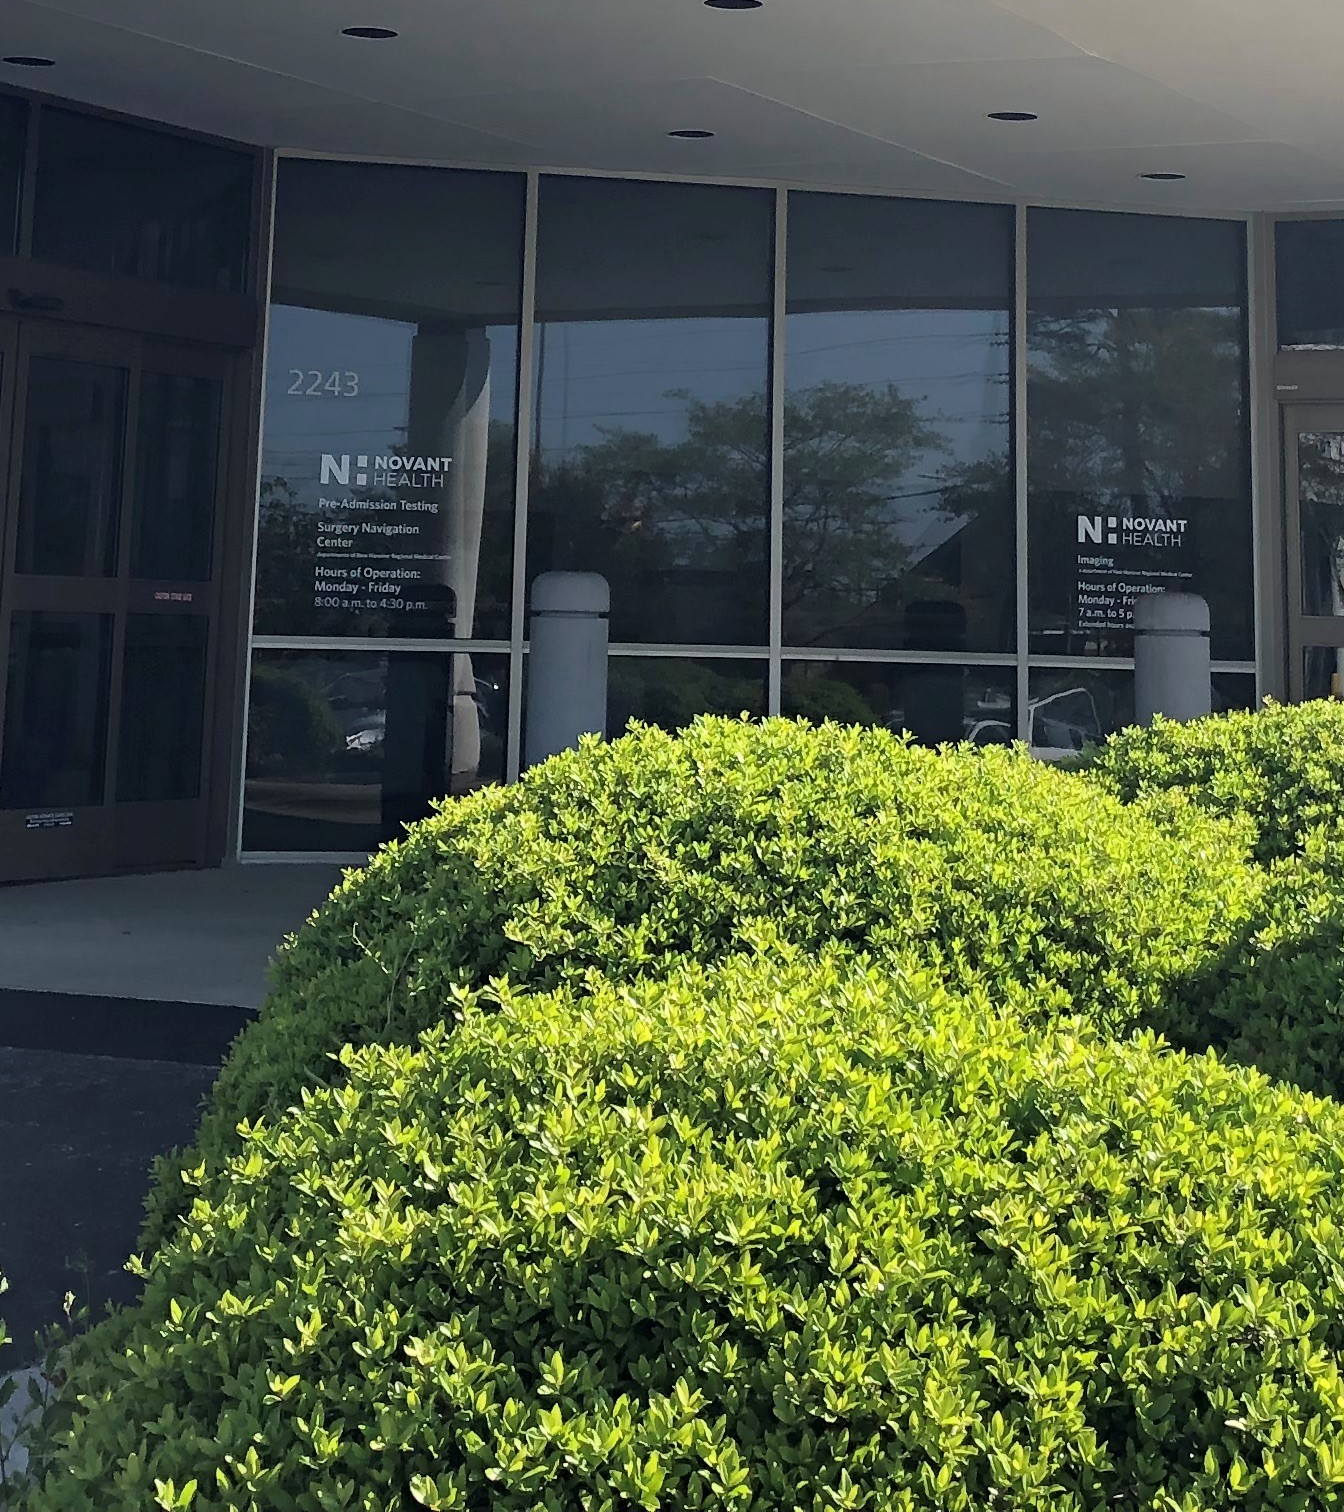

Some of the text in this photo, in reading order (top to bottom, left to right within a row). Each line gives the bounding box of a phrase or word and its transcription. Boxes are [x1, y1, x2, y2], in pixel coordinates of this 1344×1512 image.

[287, 369, 359, 396] 2243
[375, 455, 452, 471] NOVANT
[373, 472, 444, 487] HEALTH
[318, 498, 438, 514] Pre-Admission Testing
[317, 521, 419, 536] Surgery Navigation
[1122, 517, 1188, 533] NOVANT
[316, 536, 353, 548] Center
[1122, 532, 1181, 547] HEALTH
[1077, 554, 1114, 567] Imaging
[315, 566, 421, 579] Hours of Operation:
[314, 580, 359, 594] Monday
[368, 582, 401, 595] Friday
[1078, 581, 1166, 594] Hours of Operation:
[314, 597, 428, 610] 8:00 a.m. to 4:30 p.m.
[1078, 594, 1115, 606] Monday
[1122, 596, 1137, 605] Fri
[1078, 607, 1084, 617] 7
[1086, 609, 1106, 617] a.m.
[1107, 608, 1117, 618] to
[1118, 609, 1125, 618] 5
